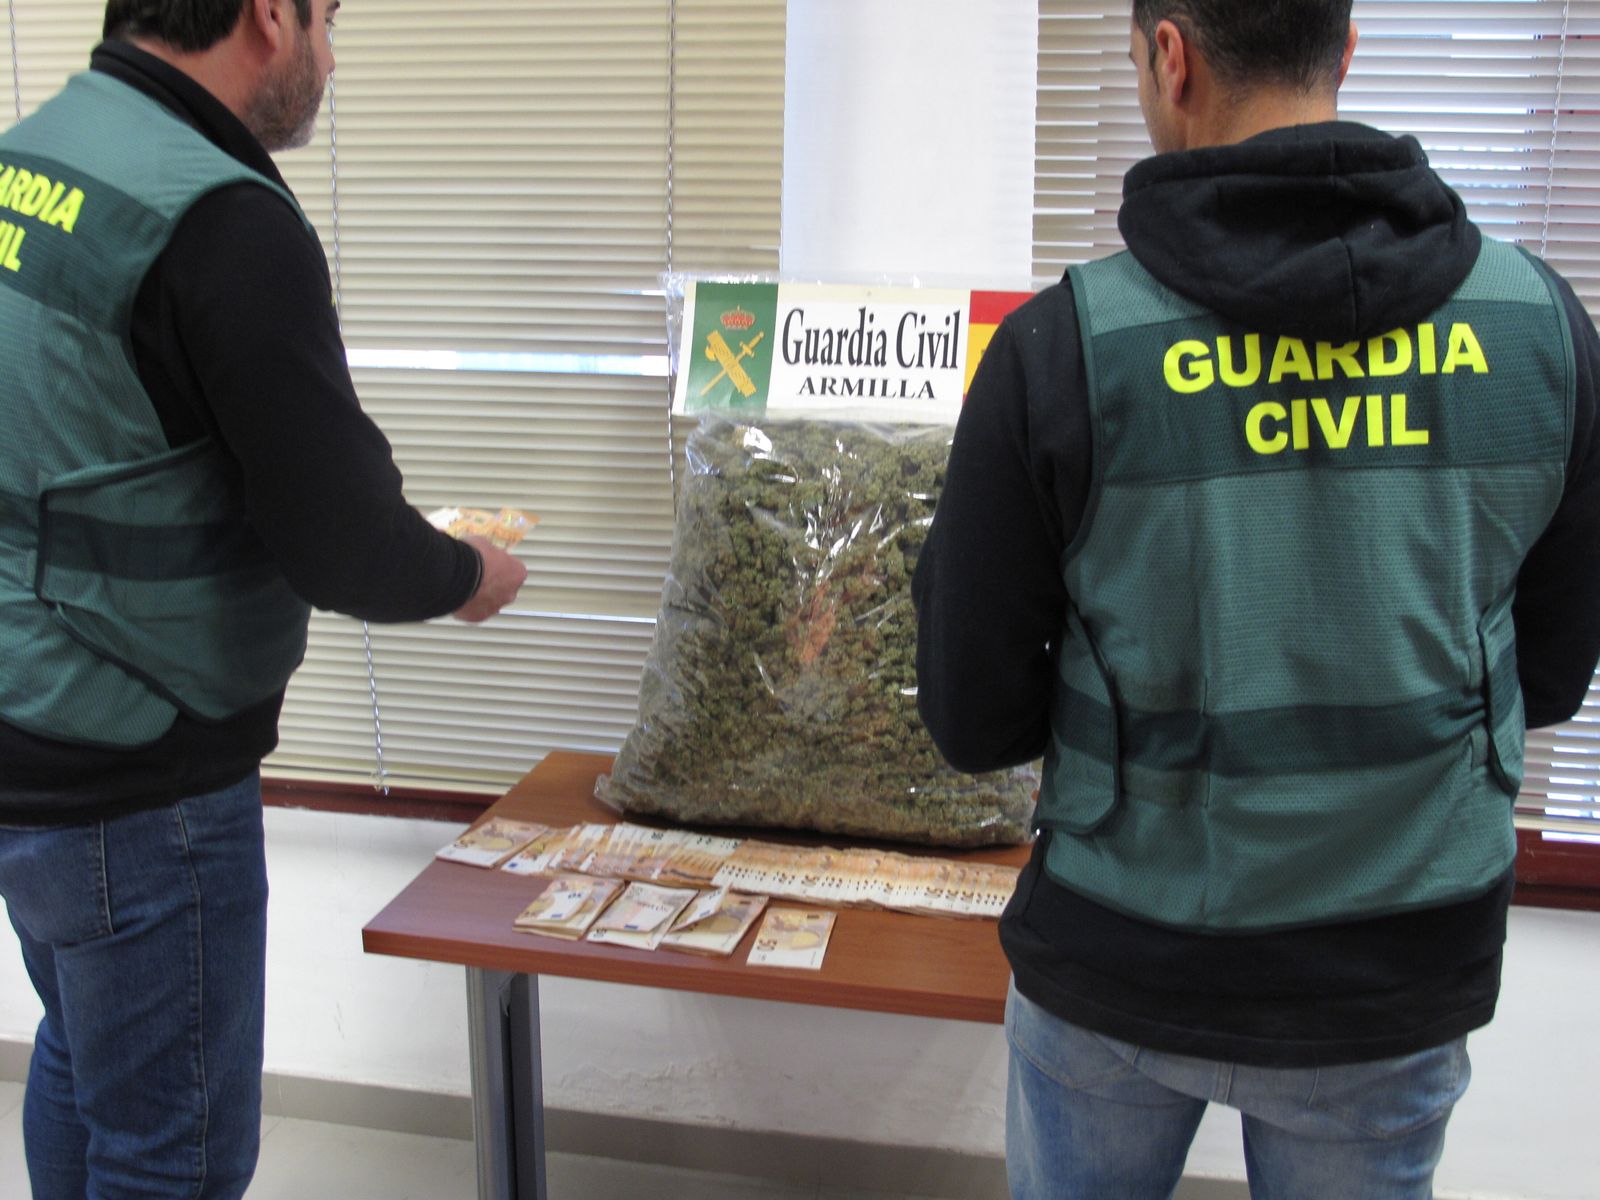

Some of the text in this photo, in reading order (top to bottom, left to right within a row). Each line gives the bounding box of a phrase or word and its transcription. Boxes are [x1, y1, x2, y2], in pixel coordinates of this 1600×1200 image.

[782, 306, 960, 369] Guardia Civil
[1163, 322, 1489, 394] GUARDIA
[797, 376, 936, 399] ARMILLA
[1245, 393, 1429, 455] CIVIL
